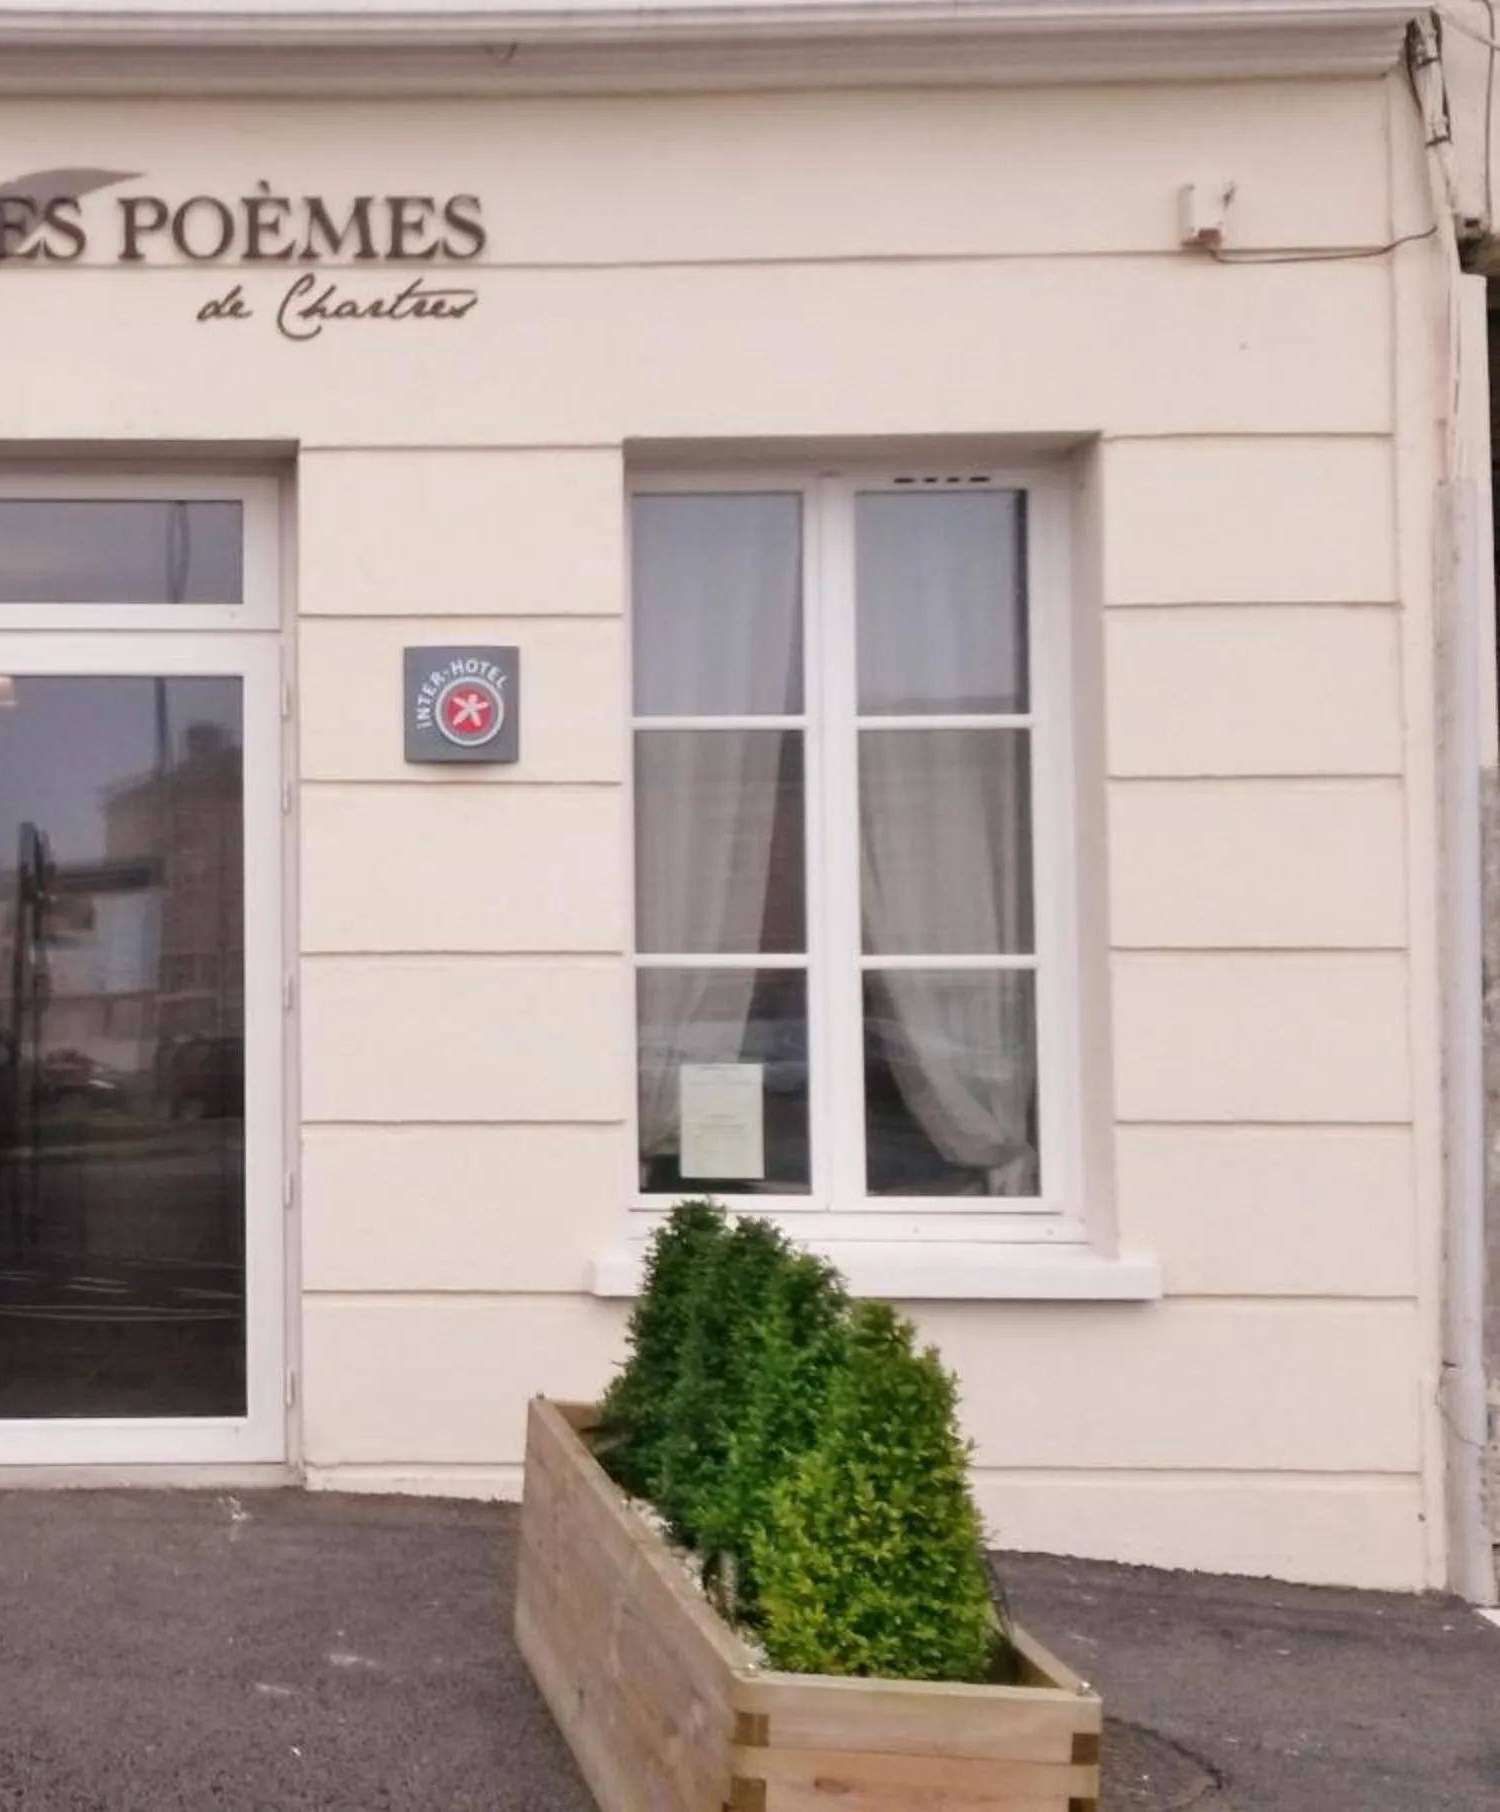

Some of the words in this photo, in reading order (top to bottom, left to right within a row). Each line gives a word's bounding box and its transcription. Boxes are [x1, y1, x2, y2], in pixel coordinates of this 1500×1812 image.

[116, 178, 488, 263] POÈMES
[195, 283, 255, 323] de
[275, 271, 480, 341] Chartres
